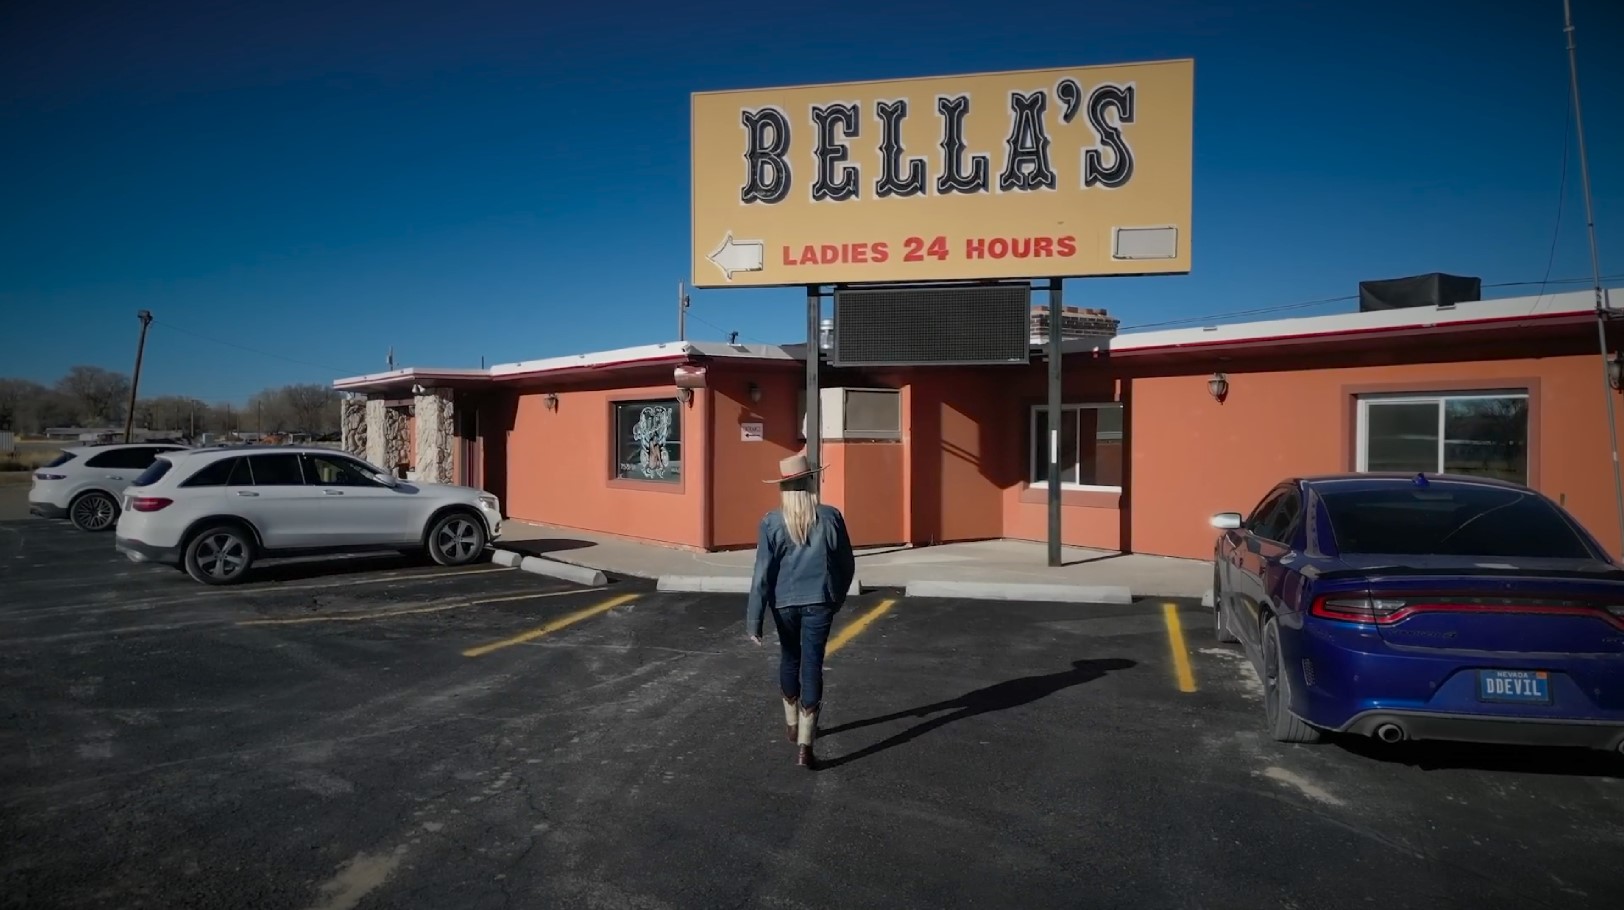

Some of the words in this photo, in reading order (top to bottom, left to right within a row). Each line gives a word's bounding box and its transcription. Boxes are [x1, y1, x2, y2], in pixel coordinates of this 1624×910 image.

[740, 79, 1136, 205] BELLA'S
[782, 242, 889, 266] LADIES
[903, 236, 949, 262] 24
[966, 236, 1077, 260] HOURS
[1486, 678, 1542, 696] DDEVIL
